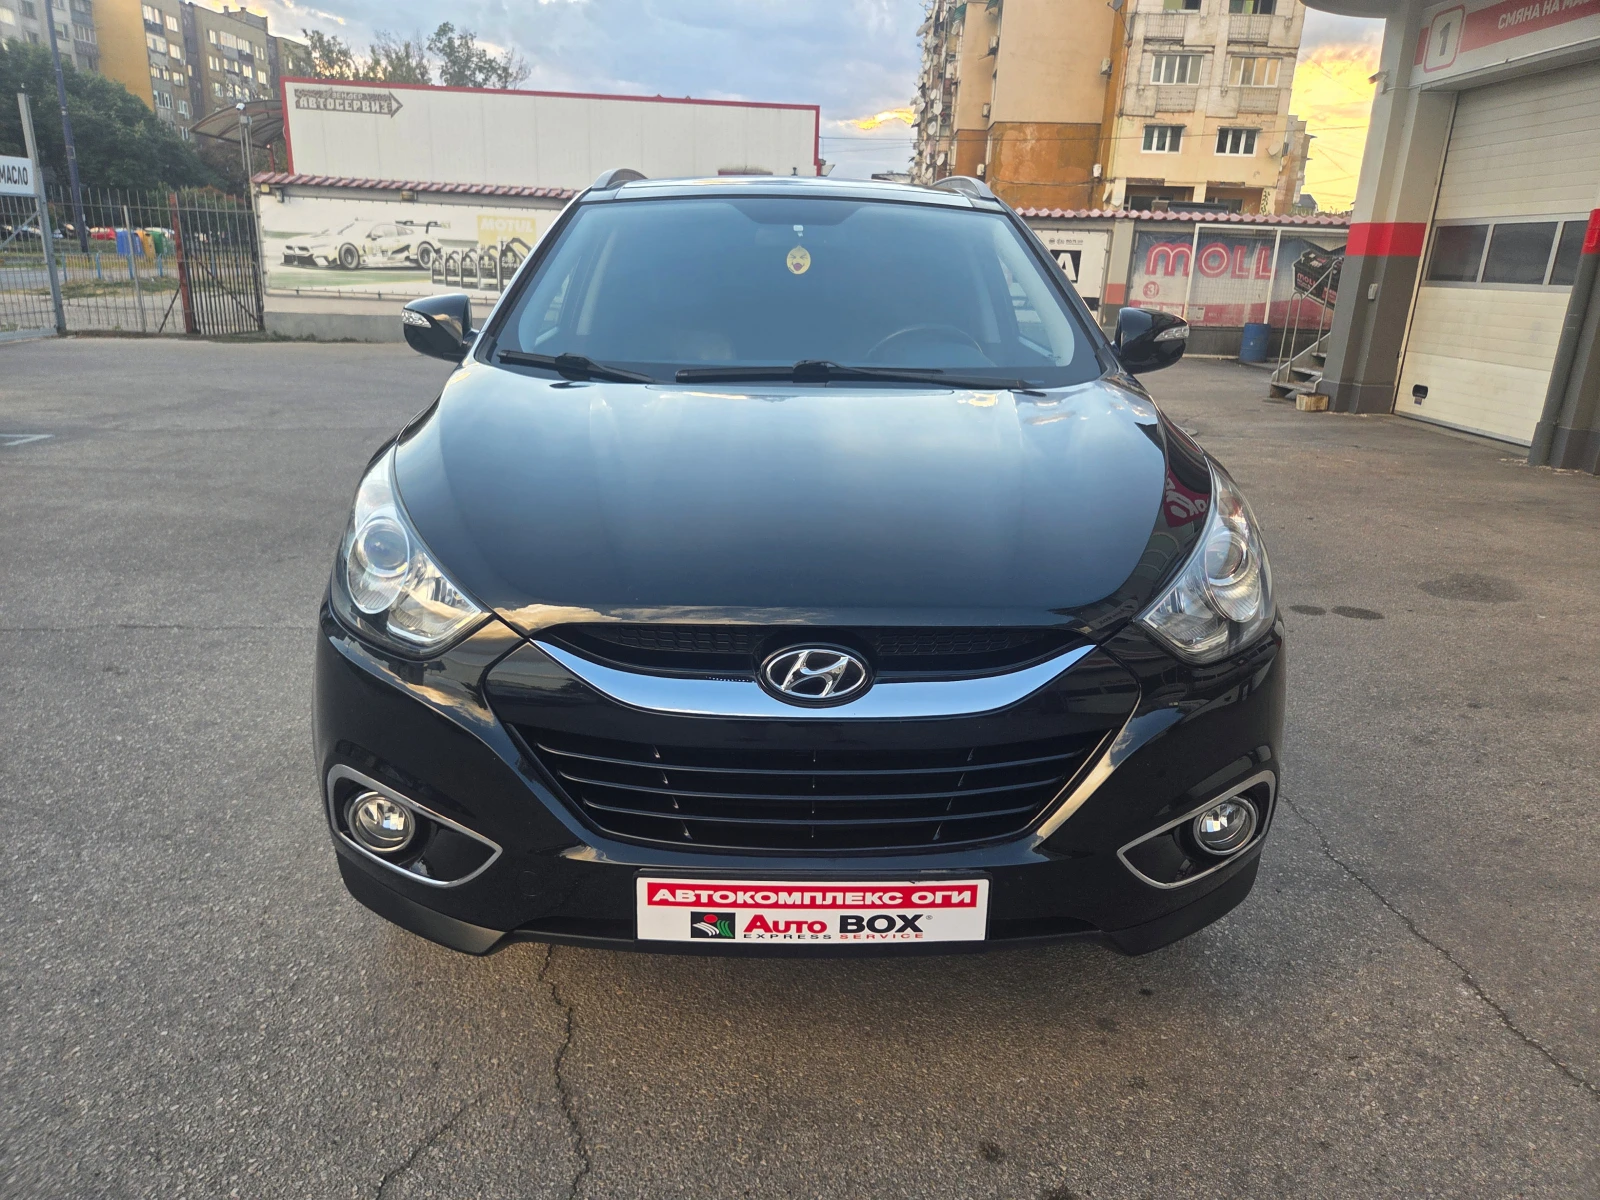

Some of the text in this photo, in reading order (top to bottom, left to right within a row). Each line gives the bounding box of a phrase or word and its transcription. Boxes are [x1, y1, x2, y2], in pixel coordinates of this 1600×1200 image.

[1497, 3, 1540, 30] СМЯНА
[1541, 0, 1560, 17] НА
[299, 96, 389, 113] АВТОСЕРВИЗ
[480, 217, 533, 233] MOTUL
[652, 888, 972, 905] АВТОКОМПЛЕКС ОГИ
